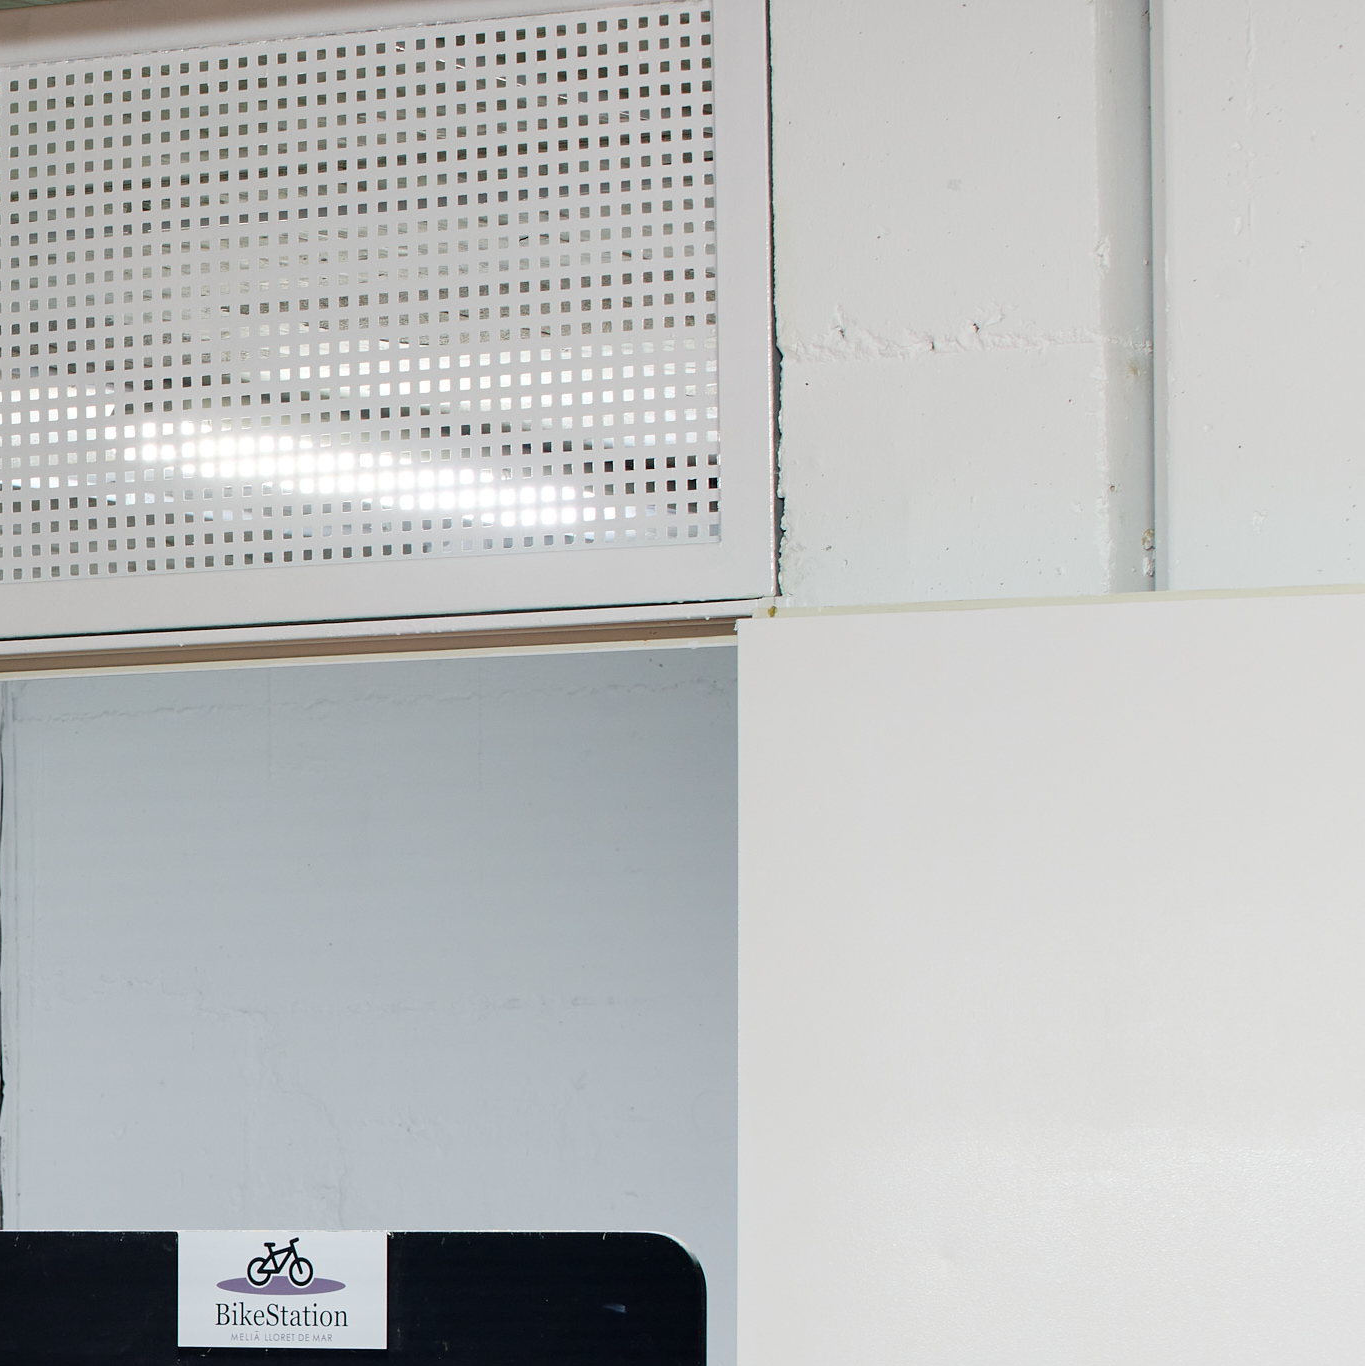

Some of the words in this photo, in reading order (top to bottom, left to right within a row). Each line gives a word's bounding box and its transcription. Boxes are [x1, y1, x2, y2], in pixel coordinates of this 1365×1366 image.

[215, 1302, 348, 1327] BikeStation
[264, 1332, 296, 1341] LLORET
[298, 1333, 310, 1342] DE
[312, 1333, 333, 1342] MAR
